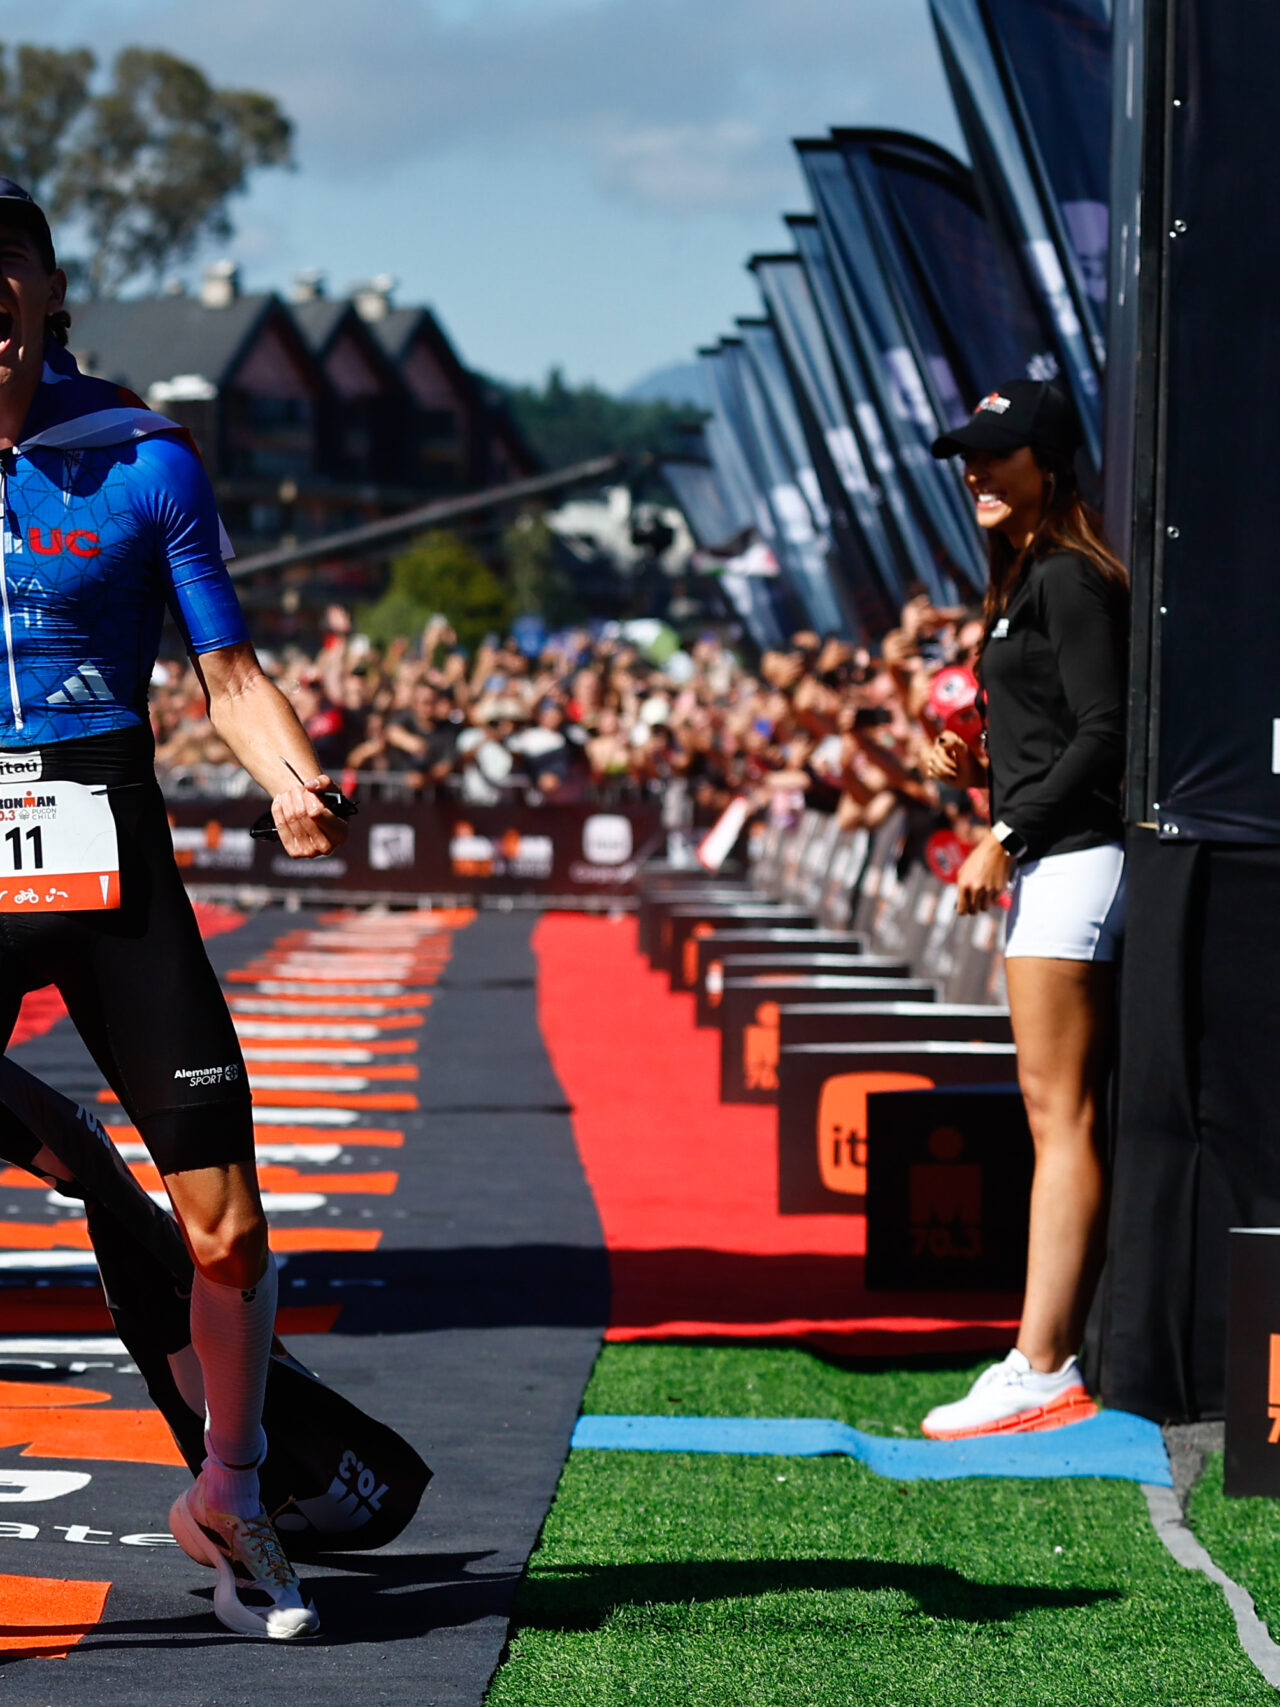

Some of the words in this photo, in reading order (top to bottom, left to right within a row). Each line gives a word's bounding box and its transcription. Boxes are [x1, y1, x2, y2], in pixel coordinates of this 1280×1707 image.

[0, 759, 38, 776] itaú
[5, 826, 44, 870] 11
[174, 1066, 223, 1079] Alemana
[189, 1074, 223, 1087] SPORT
